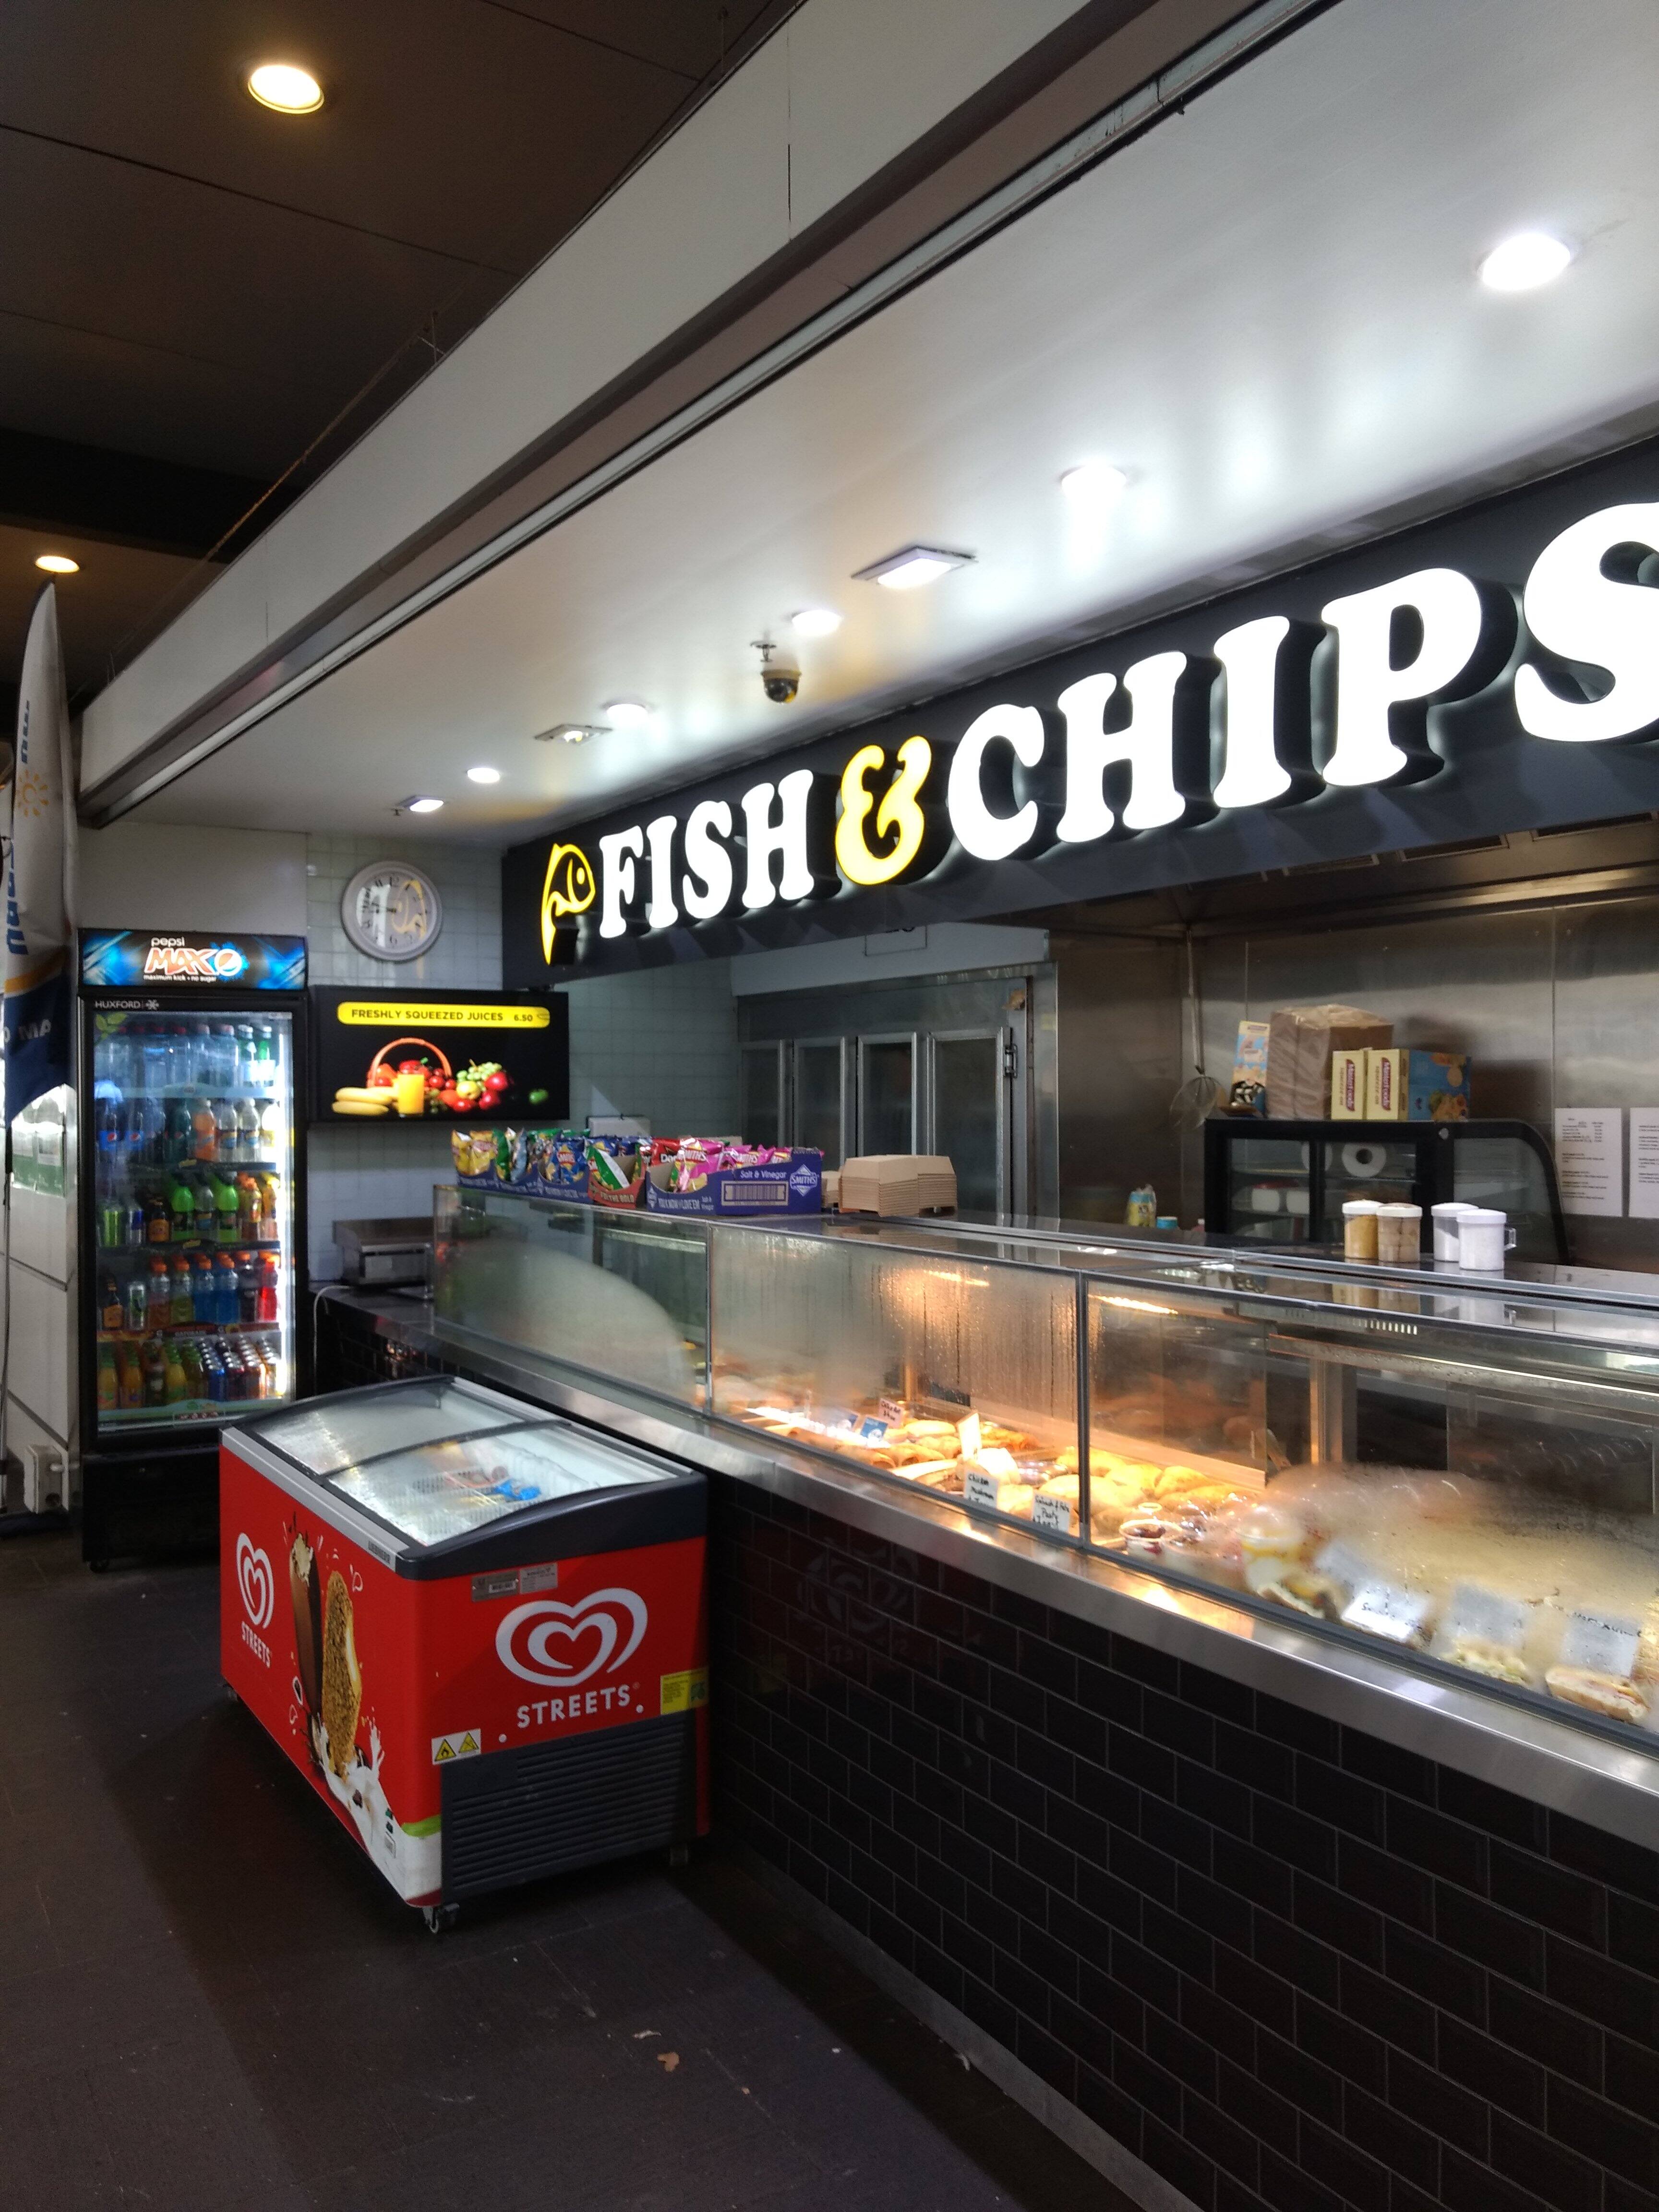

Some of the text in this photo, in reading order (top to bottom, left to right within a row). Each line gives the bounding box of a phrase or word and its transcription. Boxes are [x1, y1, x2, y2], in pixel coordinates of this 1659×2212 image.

[599, 501, 1659, 939] FISH & CHIPS
[151, 937, 185, 948] pepsi
[144, 947, 220, 975] MAX
[95, 1000, 141, 1009] HUXFORD
[351, 1009, 533, 1022] FRESHLY SQUEEZED JUICES 6.50
[740, 1170, 753, 1179] Salt
[761, 1170, 787, 1180] Vinegar
[241, 1621, 271, 1668] STREETS
[517, 1683, 631, 1729] STREETS
